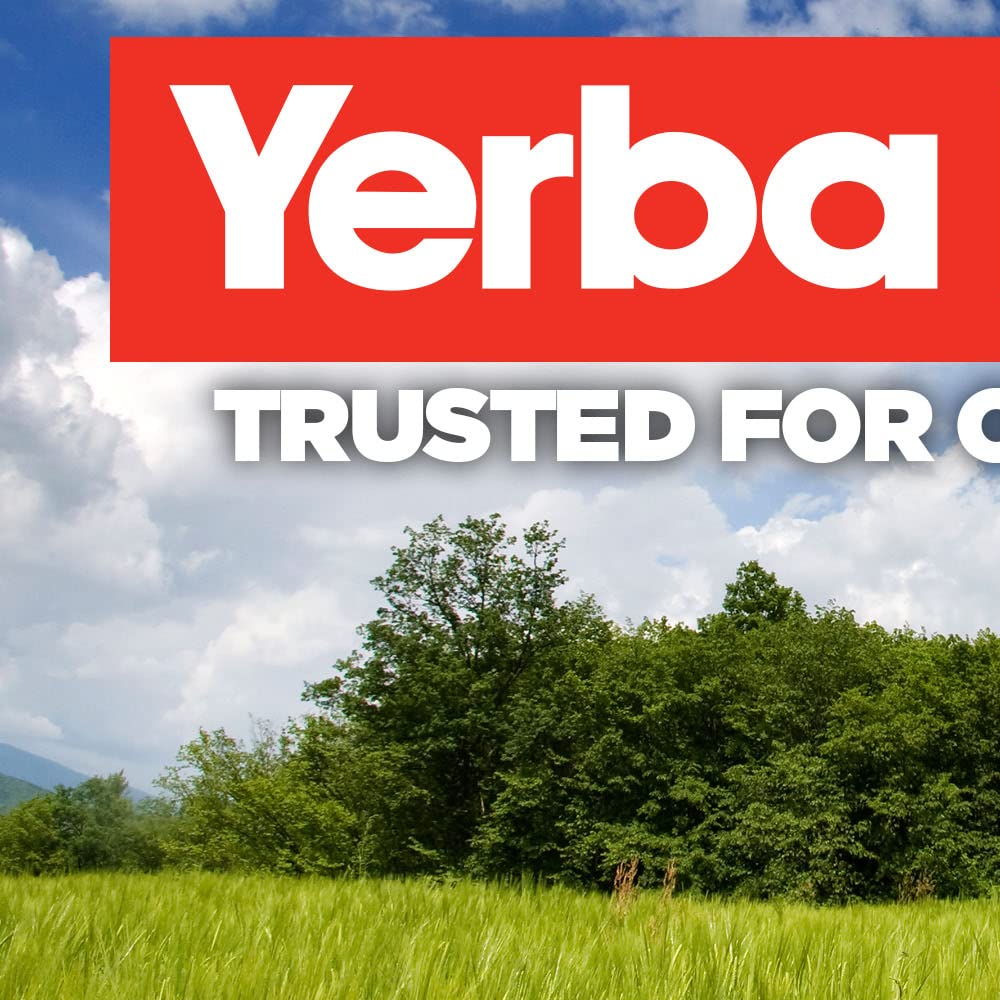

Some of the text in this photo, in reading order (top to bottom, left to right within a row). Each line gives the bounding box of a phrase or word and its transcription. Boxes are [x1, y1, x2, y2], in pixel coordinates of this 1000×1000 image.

[170, 85, 938, 291] Yerba
[214, 388, 696, 464] TRUSTED
[722, 389, 933, 463] FOR
